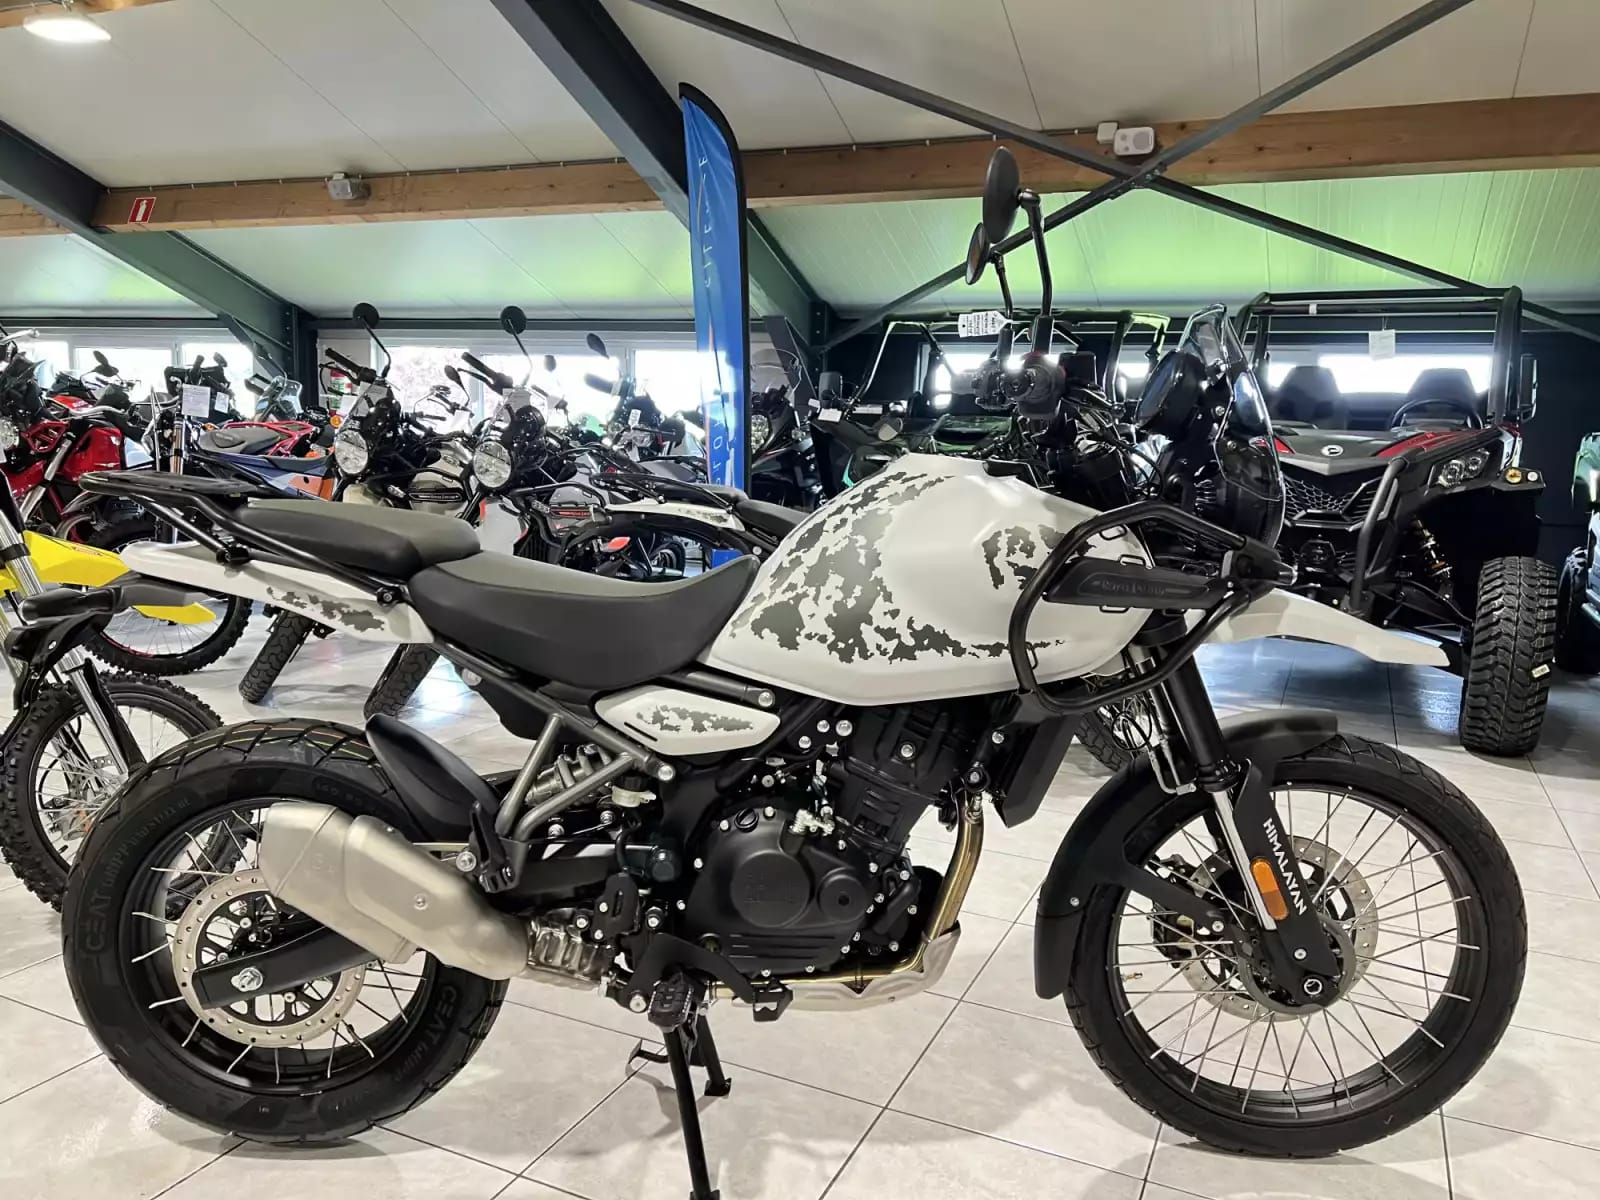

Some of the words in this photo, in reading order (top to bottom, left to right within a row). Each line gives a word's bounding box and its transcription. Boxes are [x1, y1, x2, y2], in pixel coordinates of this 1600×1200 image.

[1263, 818, 1307, 915] HIMALAYAN
[85, 889, 112, 953] CEAT
[425, 985, 457, 1046] CEAT
